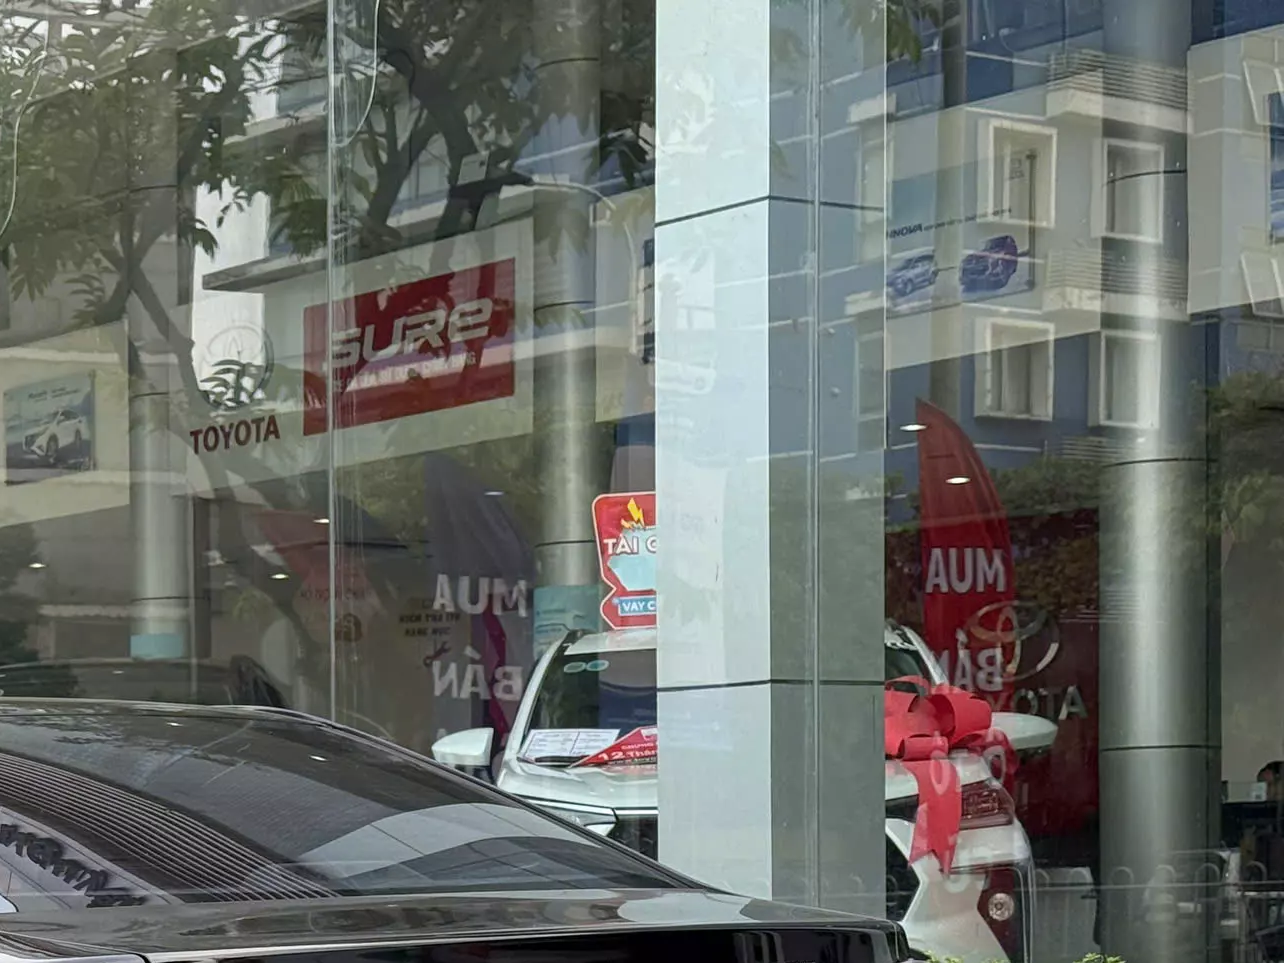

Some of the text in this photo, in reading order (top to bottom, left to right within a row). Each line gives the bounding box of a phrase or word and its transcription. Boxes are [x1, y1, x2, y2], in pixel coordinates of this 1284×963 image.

[189, 414, 281, 455] TOYOTA
[604, 534, 639, 556] TÀI
[622, 601, 645, 611] VAY
